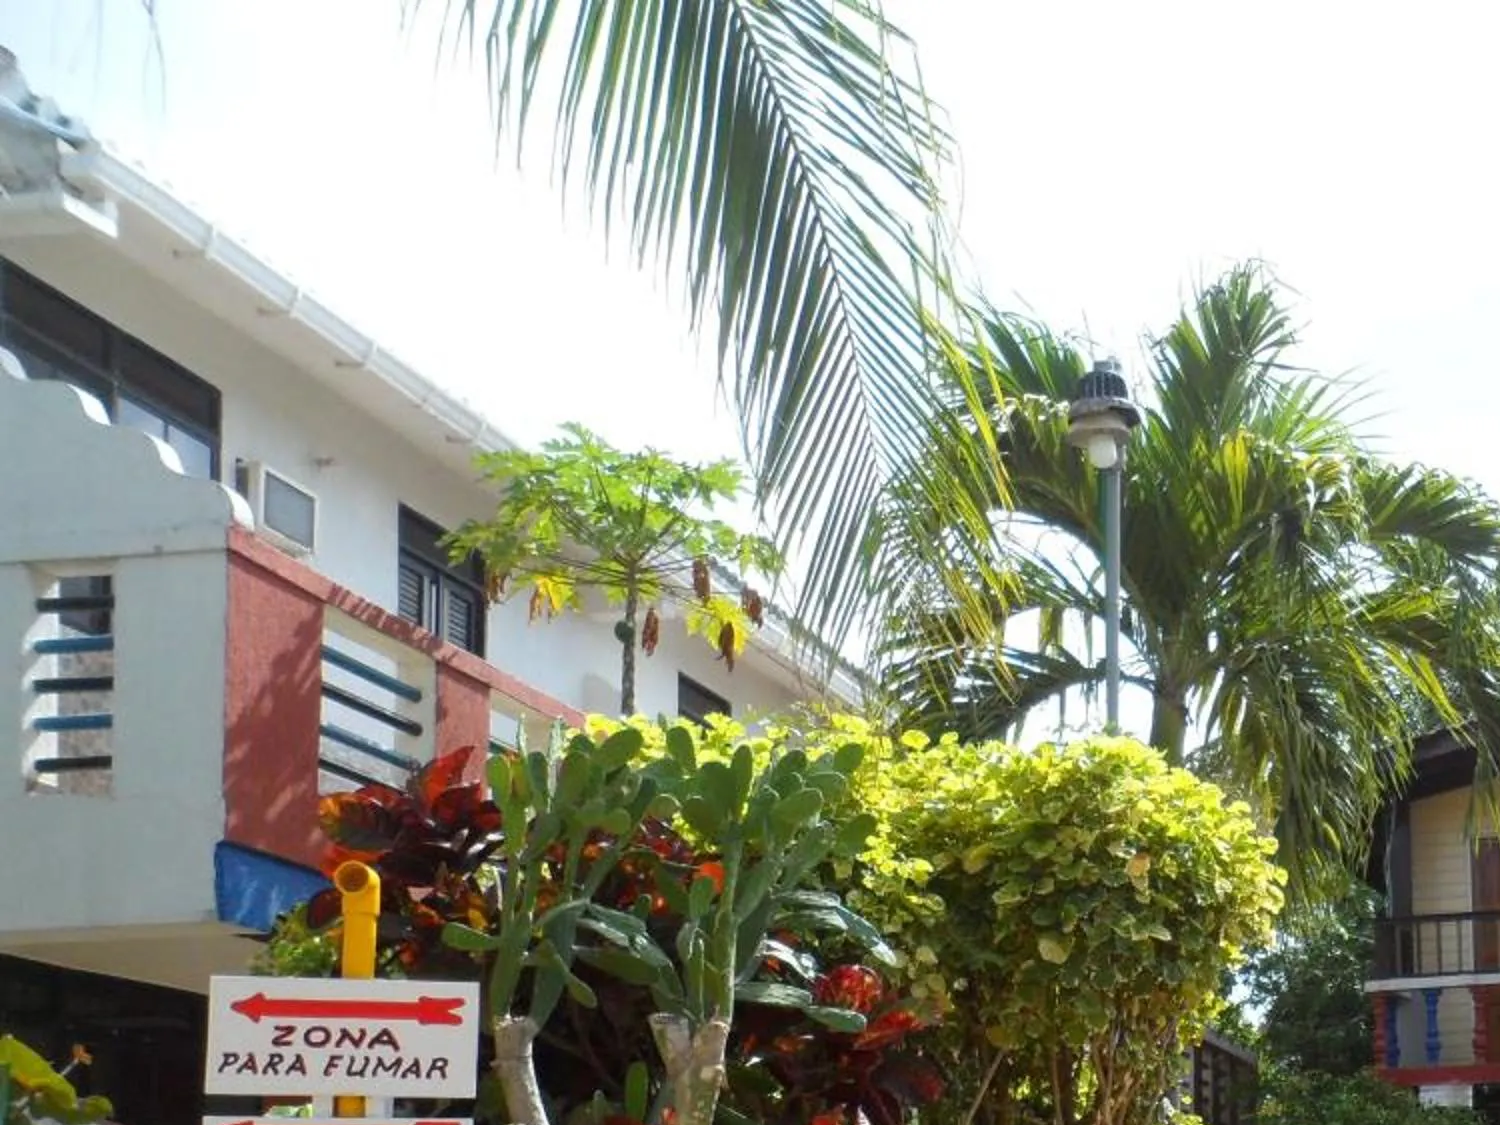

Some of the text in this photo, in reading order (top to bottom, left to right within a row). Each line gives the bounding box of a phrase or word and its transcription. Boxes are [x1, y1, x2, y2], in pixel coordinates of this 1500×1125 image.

[271, 1025, 400, 1050] ZONA
[218, 1053, 449, 1080] PARA FUMAR
